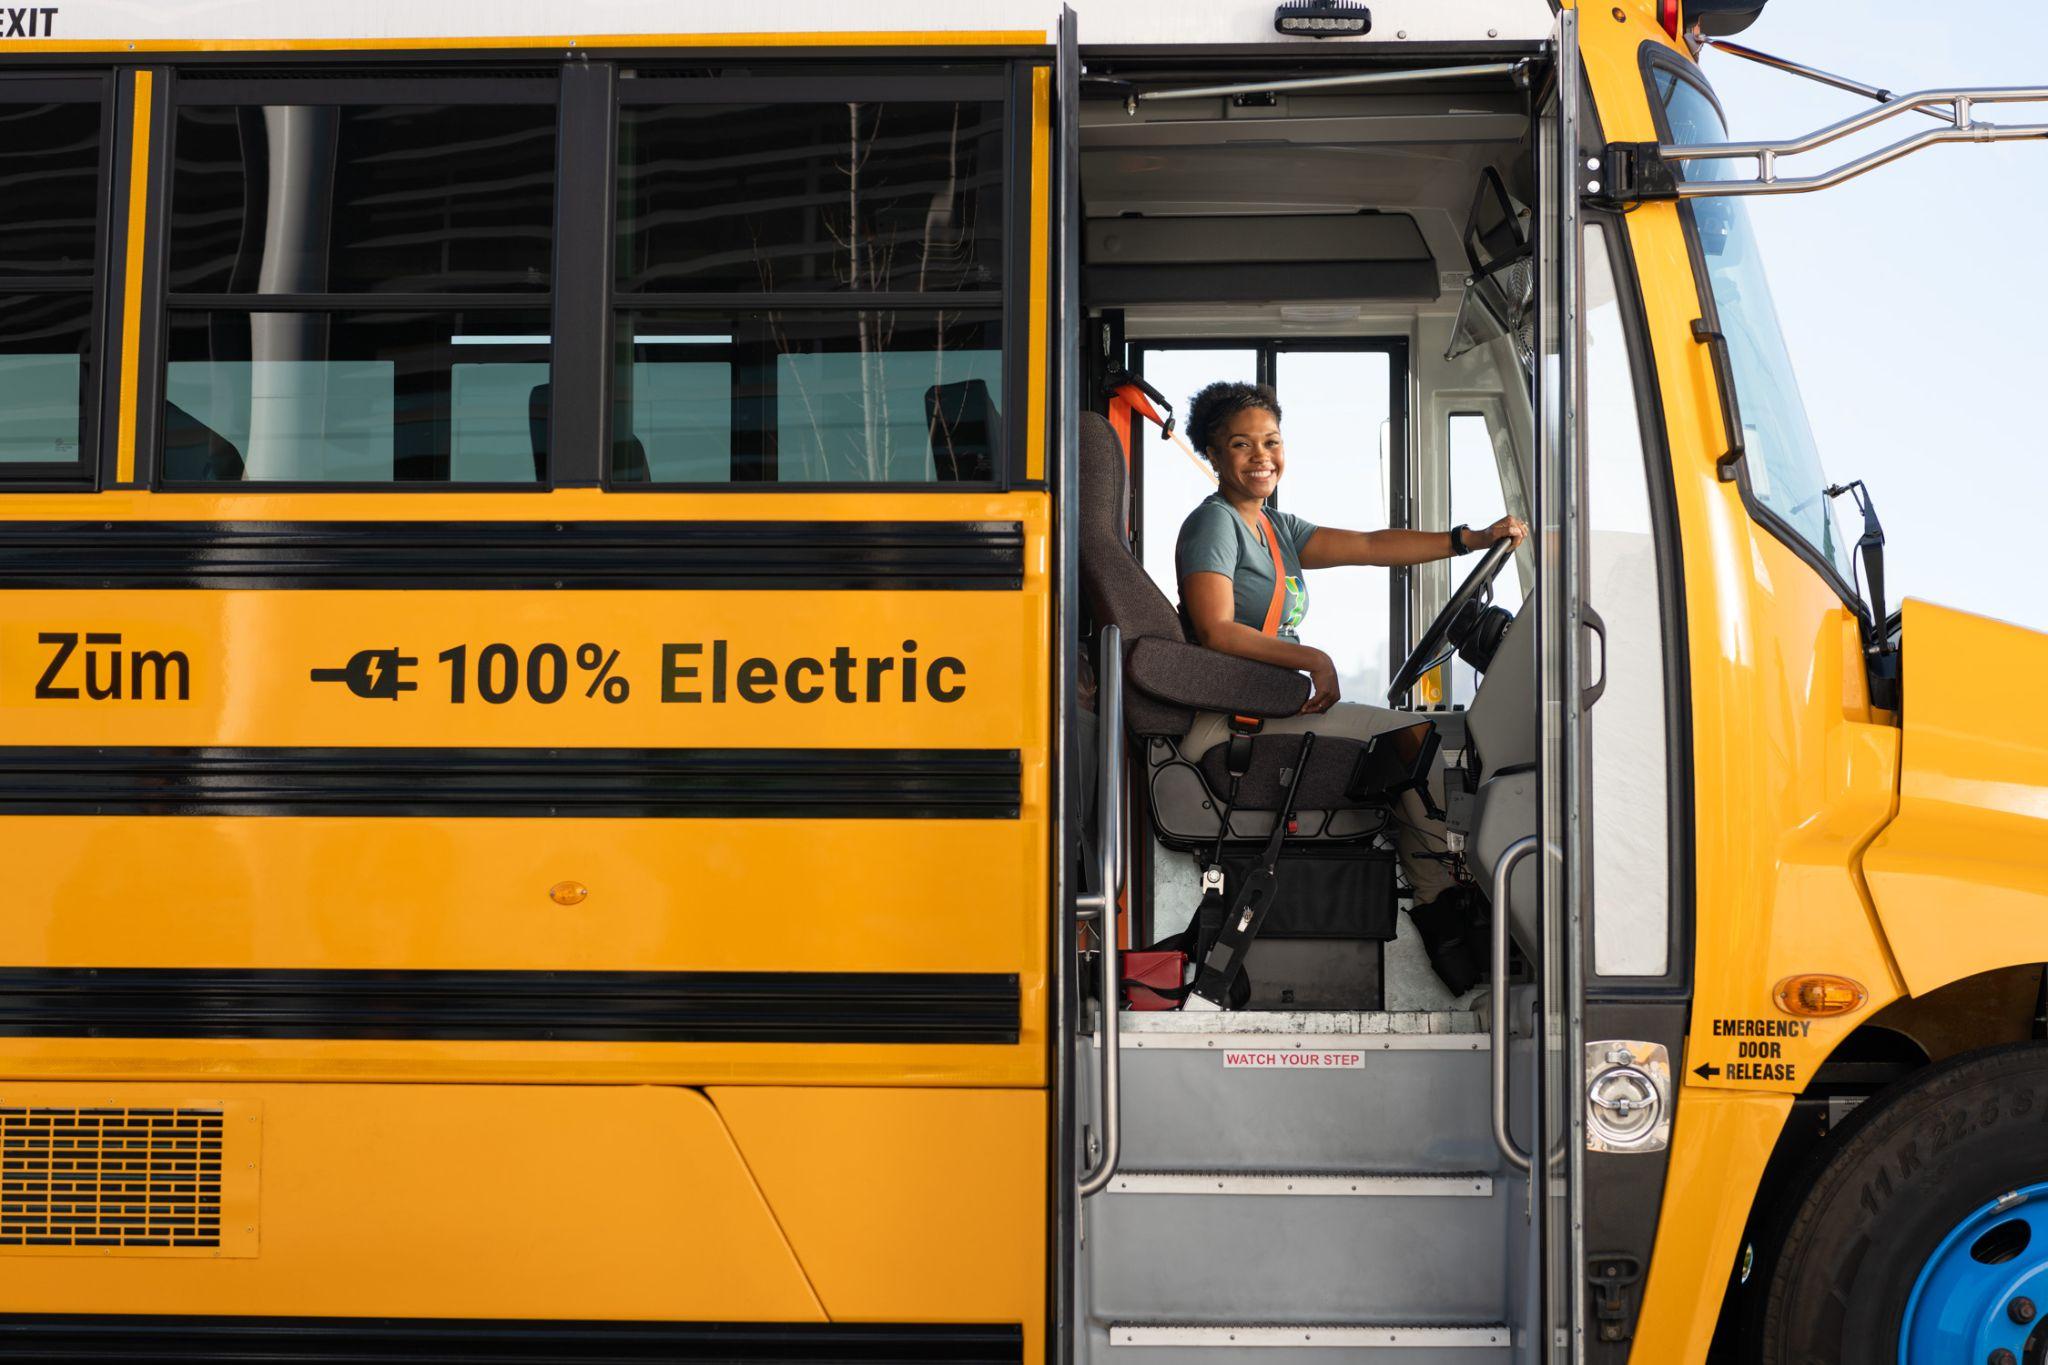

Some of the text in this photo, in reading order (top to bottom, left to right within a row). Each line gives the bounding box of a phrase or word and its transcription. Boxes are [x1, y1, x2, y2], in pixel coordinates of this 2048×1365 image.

[0, 8, 58, 37] XIT
[35, 633, 190, 700] Zūm
[438, 639, 966, 704] 100% Electric
[1713, 1019, 1811, 1037] EMERGENCY
[1738, 1041, 1781, 1058] DOOR
[1227, 1054, 1359, 1065] WATCH YOUR STEP
[1726, 1063, 1795, 1081] RELEASE
